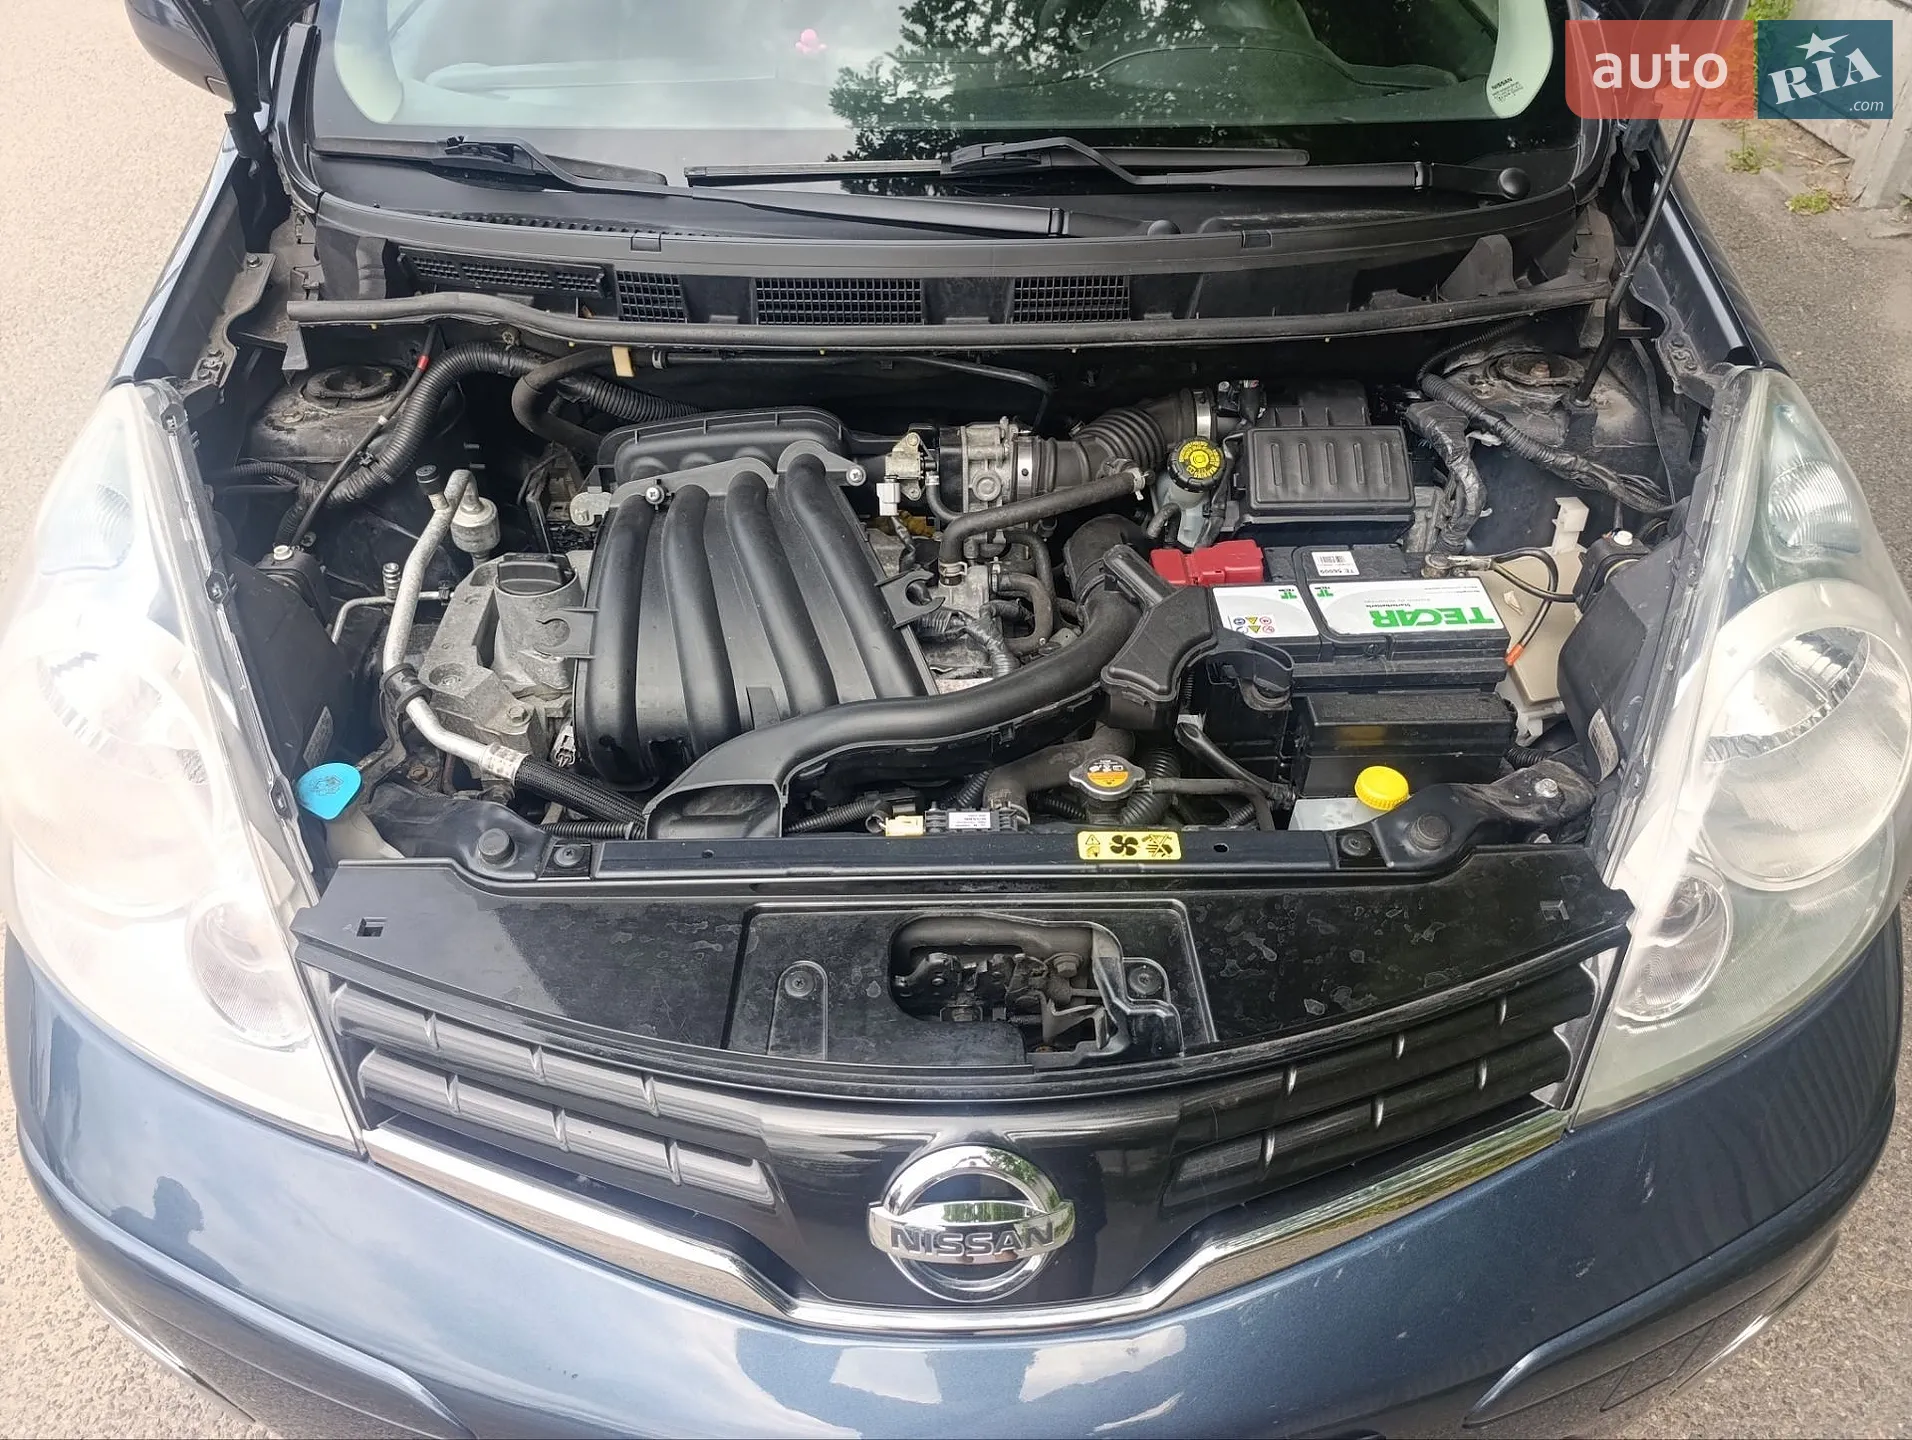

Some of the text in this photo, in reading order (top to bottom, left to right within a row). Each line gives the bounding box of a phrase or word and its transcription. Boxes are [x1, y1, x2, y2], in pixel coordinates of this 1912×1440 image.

[1491, 76, 1513, 90] NISSAN
[1369, 606, 1496, 628] TECAR
[889, 1220, 1055, 1257] NISSAN
